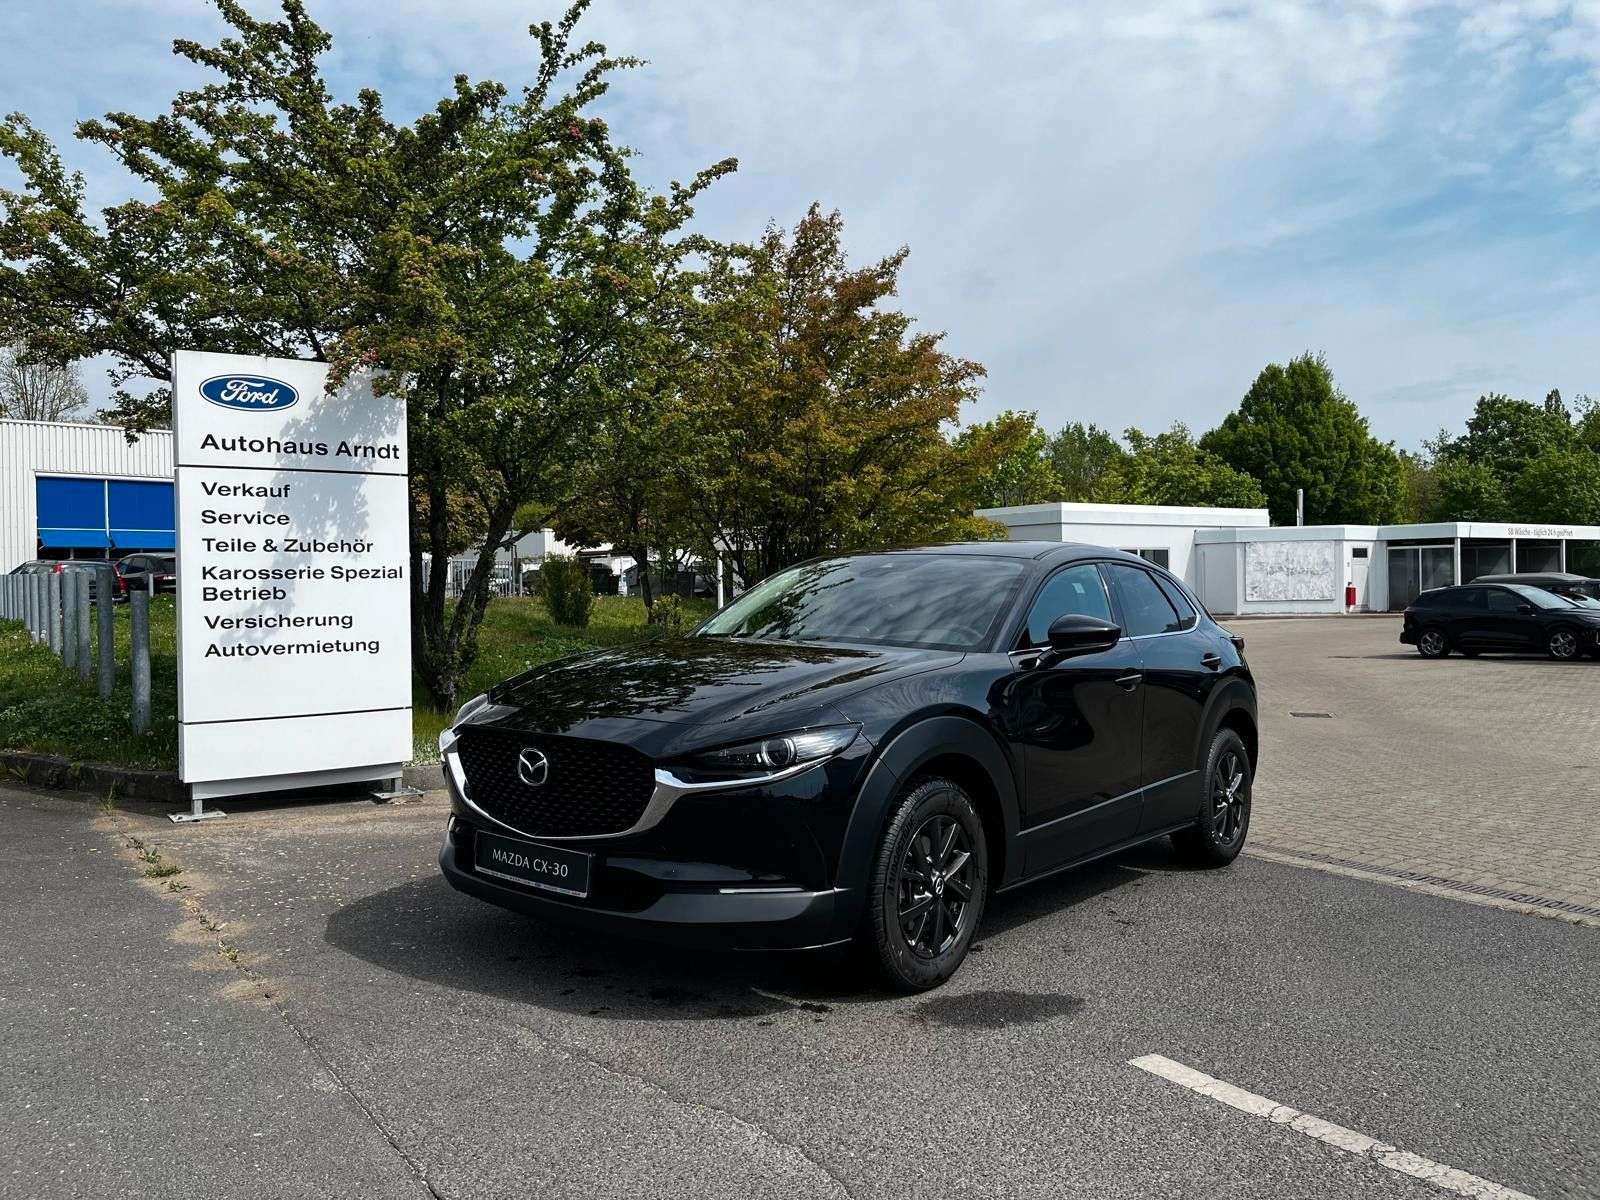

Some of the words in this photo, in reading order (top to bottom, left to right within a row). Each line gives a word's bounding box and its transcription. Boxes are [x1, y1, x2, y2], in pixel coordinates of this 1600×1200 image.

[220, 379, 279, 405] Ford
[200, 434, 329, 456] Autohaus
[335, 441, 400, 460] Arndt
[201, 482, 291, 498] Verkauf
[201, 510, 290, 526] Service
[202, 538, 257, 553] Teile
[262, 539, 278, 553] &
[283, 539, 374, 553] Zubehör
[202, 566, 325, 580] Karosserie
[330, 566, 403, 582] Spezial
[202, 587, 287, 602] Betrieb
[204, 614, 354, 630] Versicherung
[204, 640, 380, 658] Autovermietung
[492, 848, 530, 869] MAZDA
[533, 858, 569, 878] CX-30
